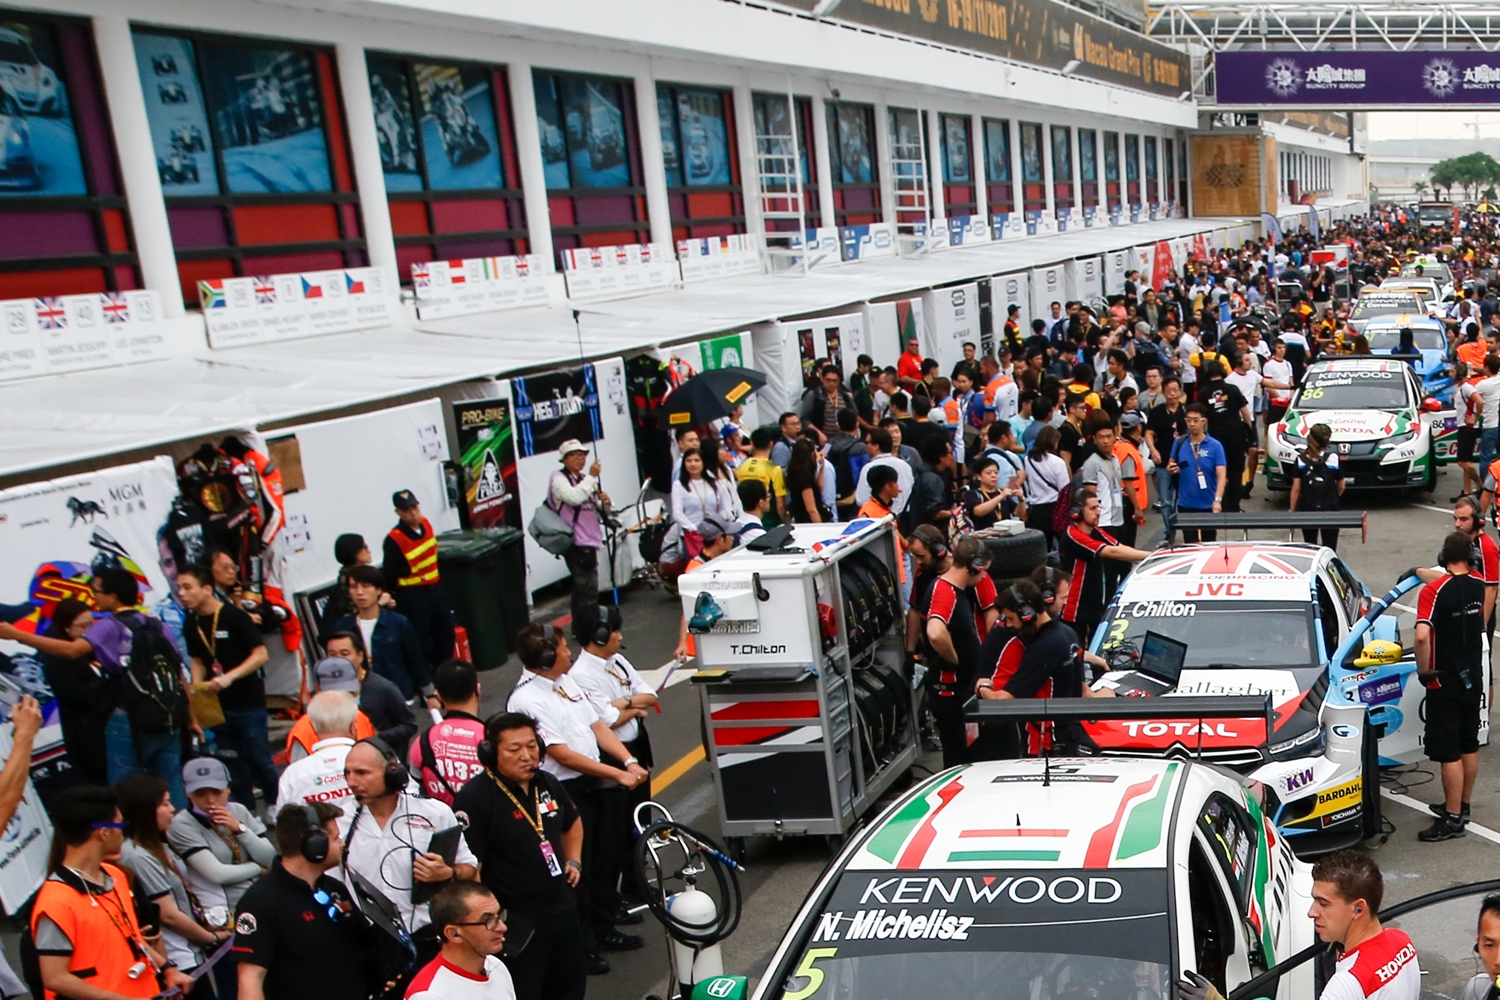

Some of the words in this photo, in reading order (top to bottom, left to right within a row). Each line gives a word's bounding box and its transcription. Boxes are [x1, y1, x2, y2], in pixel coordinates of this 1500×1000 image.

[1315, 377, 1352, 388] Guerrieri
[1318, 371, 1392, 379] KENWOOD
[1301, 387, 1325, 401] 86
[461, 406, 506, 424] PRO-BIKE
[1432, 419, 1444, 429] 86
[1400, 449, 1416, 458] KW
[108, 483, 145, 501] MGM
[1185, 583, 1244, 597] JVC
[1115, 602, 1131, 619] T.
[1132, 600, 1197, 618] Chilton
[1102, 619, 1130, 650] 3
[1180, 682, 1294, 698] allagher
[1121, 720, 1238, 738] TOTAL
[1287, 767, 1315, 792] KW
[1319, 782, 1363, 805] BARDAHL
[1330, 807, 1357, 823] YOKOHAMA
[859, 876, 1123, 905] KENWOOD
[812, 912, 841, 943] N.
[845, 908, 975, 942] Michelisz
[1374, 942, 1417, 983] HONDA
